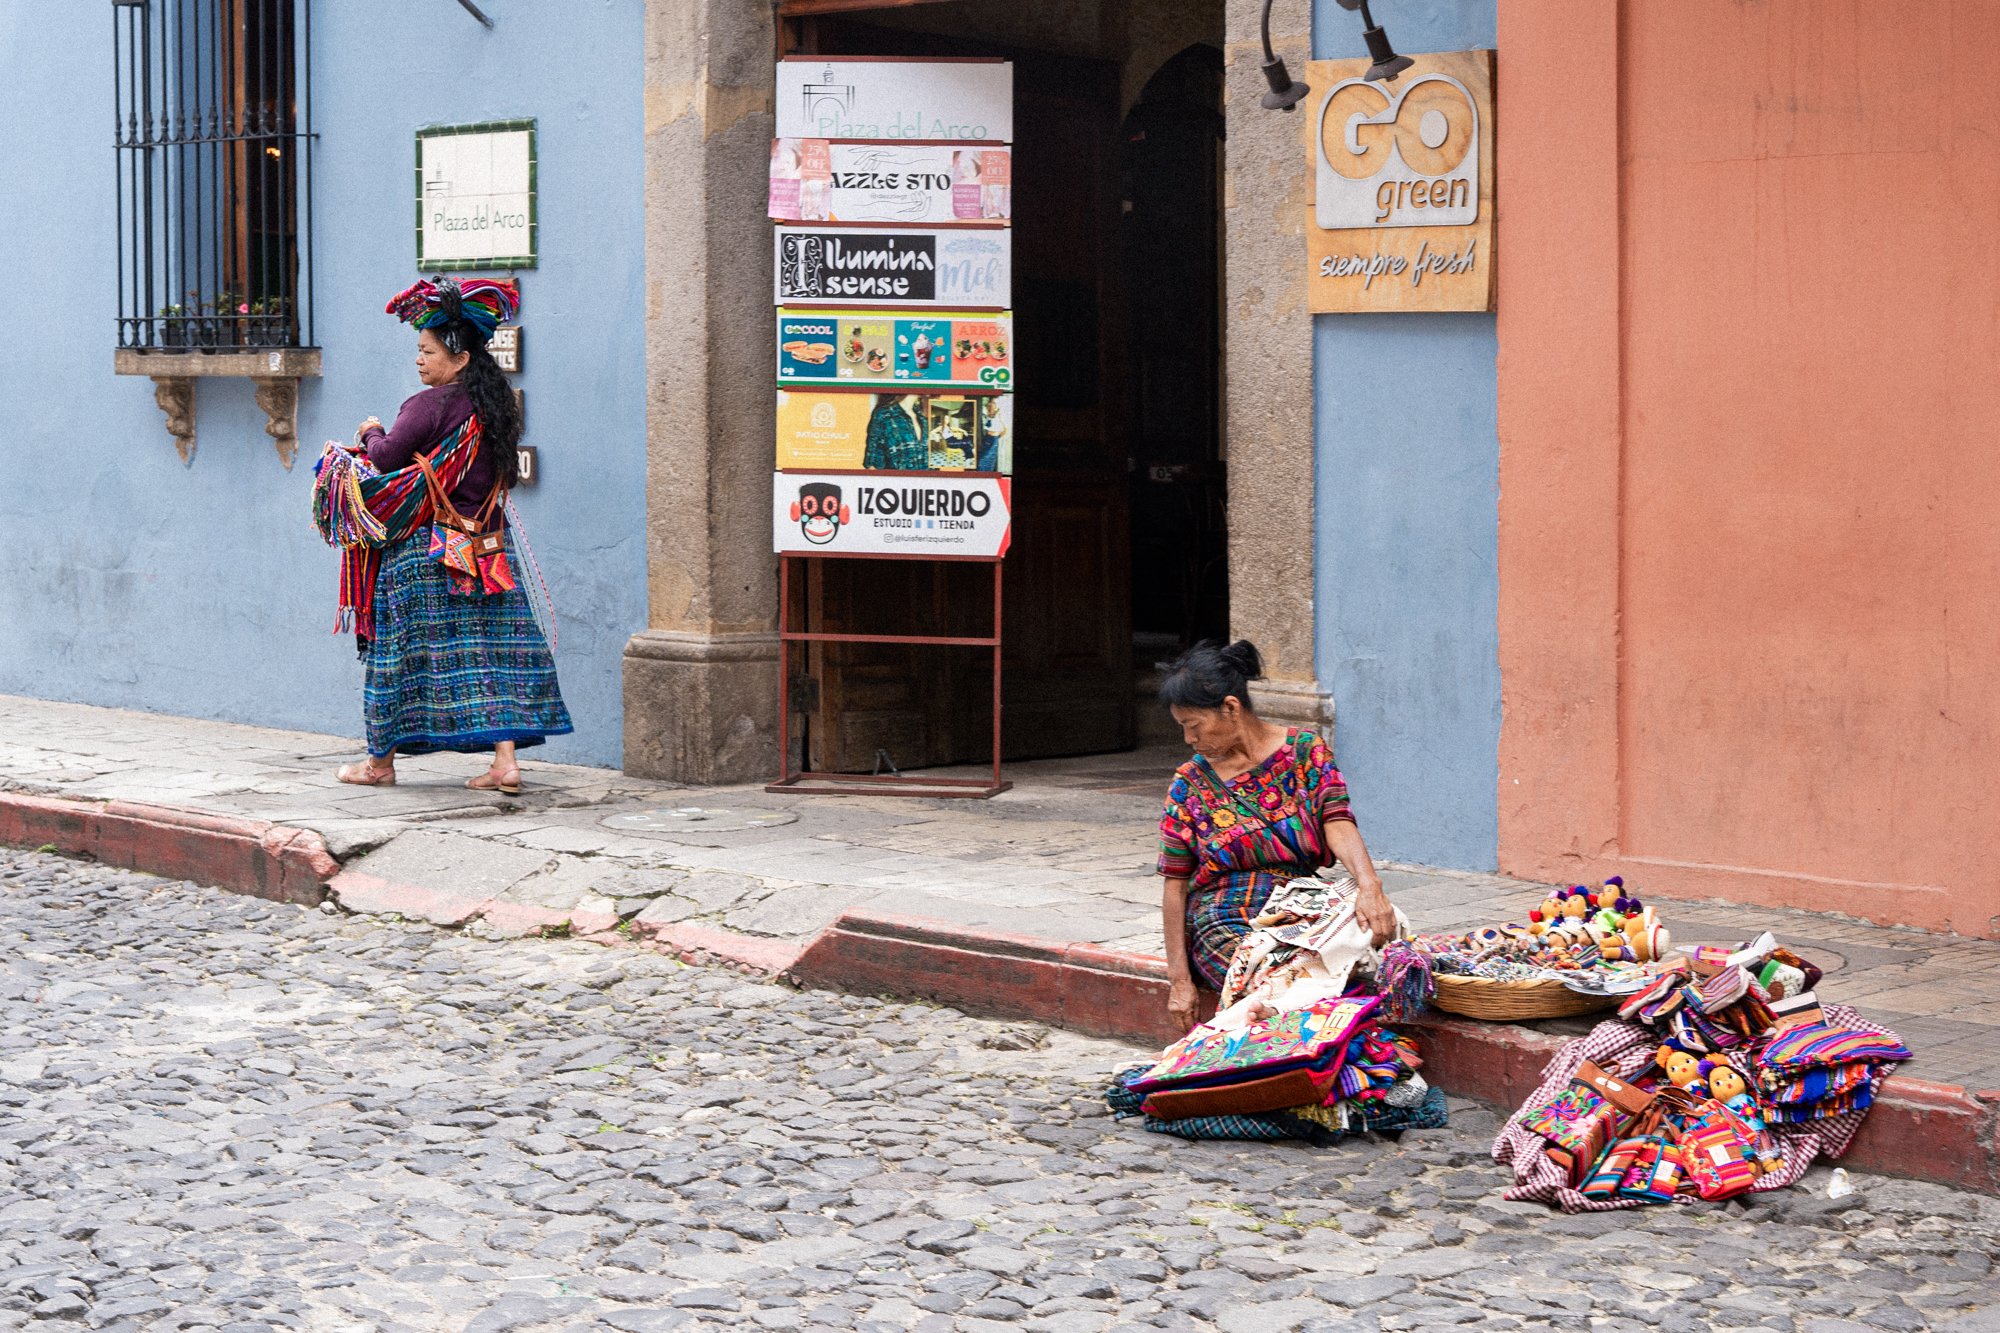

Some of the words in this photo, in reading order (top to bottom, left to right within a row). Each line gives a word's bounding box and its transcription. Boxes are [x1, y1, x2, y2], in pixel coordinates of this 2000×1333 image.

[817, 111, 880, 138] Plaza
[886, 111, 922, 138] del
[928, 118, 988, 139] Arco
[1321, 78, 1474, 180] GO
[1376, 178, 1470, 223] green
[433, 206, 469, 232] Plaza
[471, 203, 489, 230] del
[493, 210, 526, 229] Arco
[1319, 252, 1409, 290] siempre
[1411, 238, 1477, 288] fresh
[825, 276, 910, 296] sense
[979, 367, 1011, 383] GO
[857, 487, 991, 518] IZQUIERDO
[873, 518, 912, 529] ESTUDIO
[938, 519, 975, 530] TIENDA
